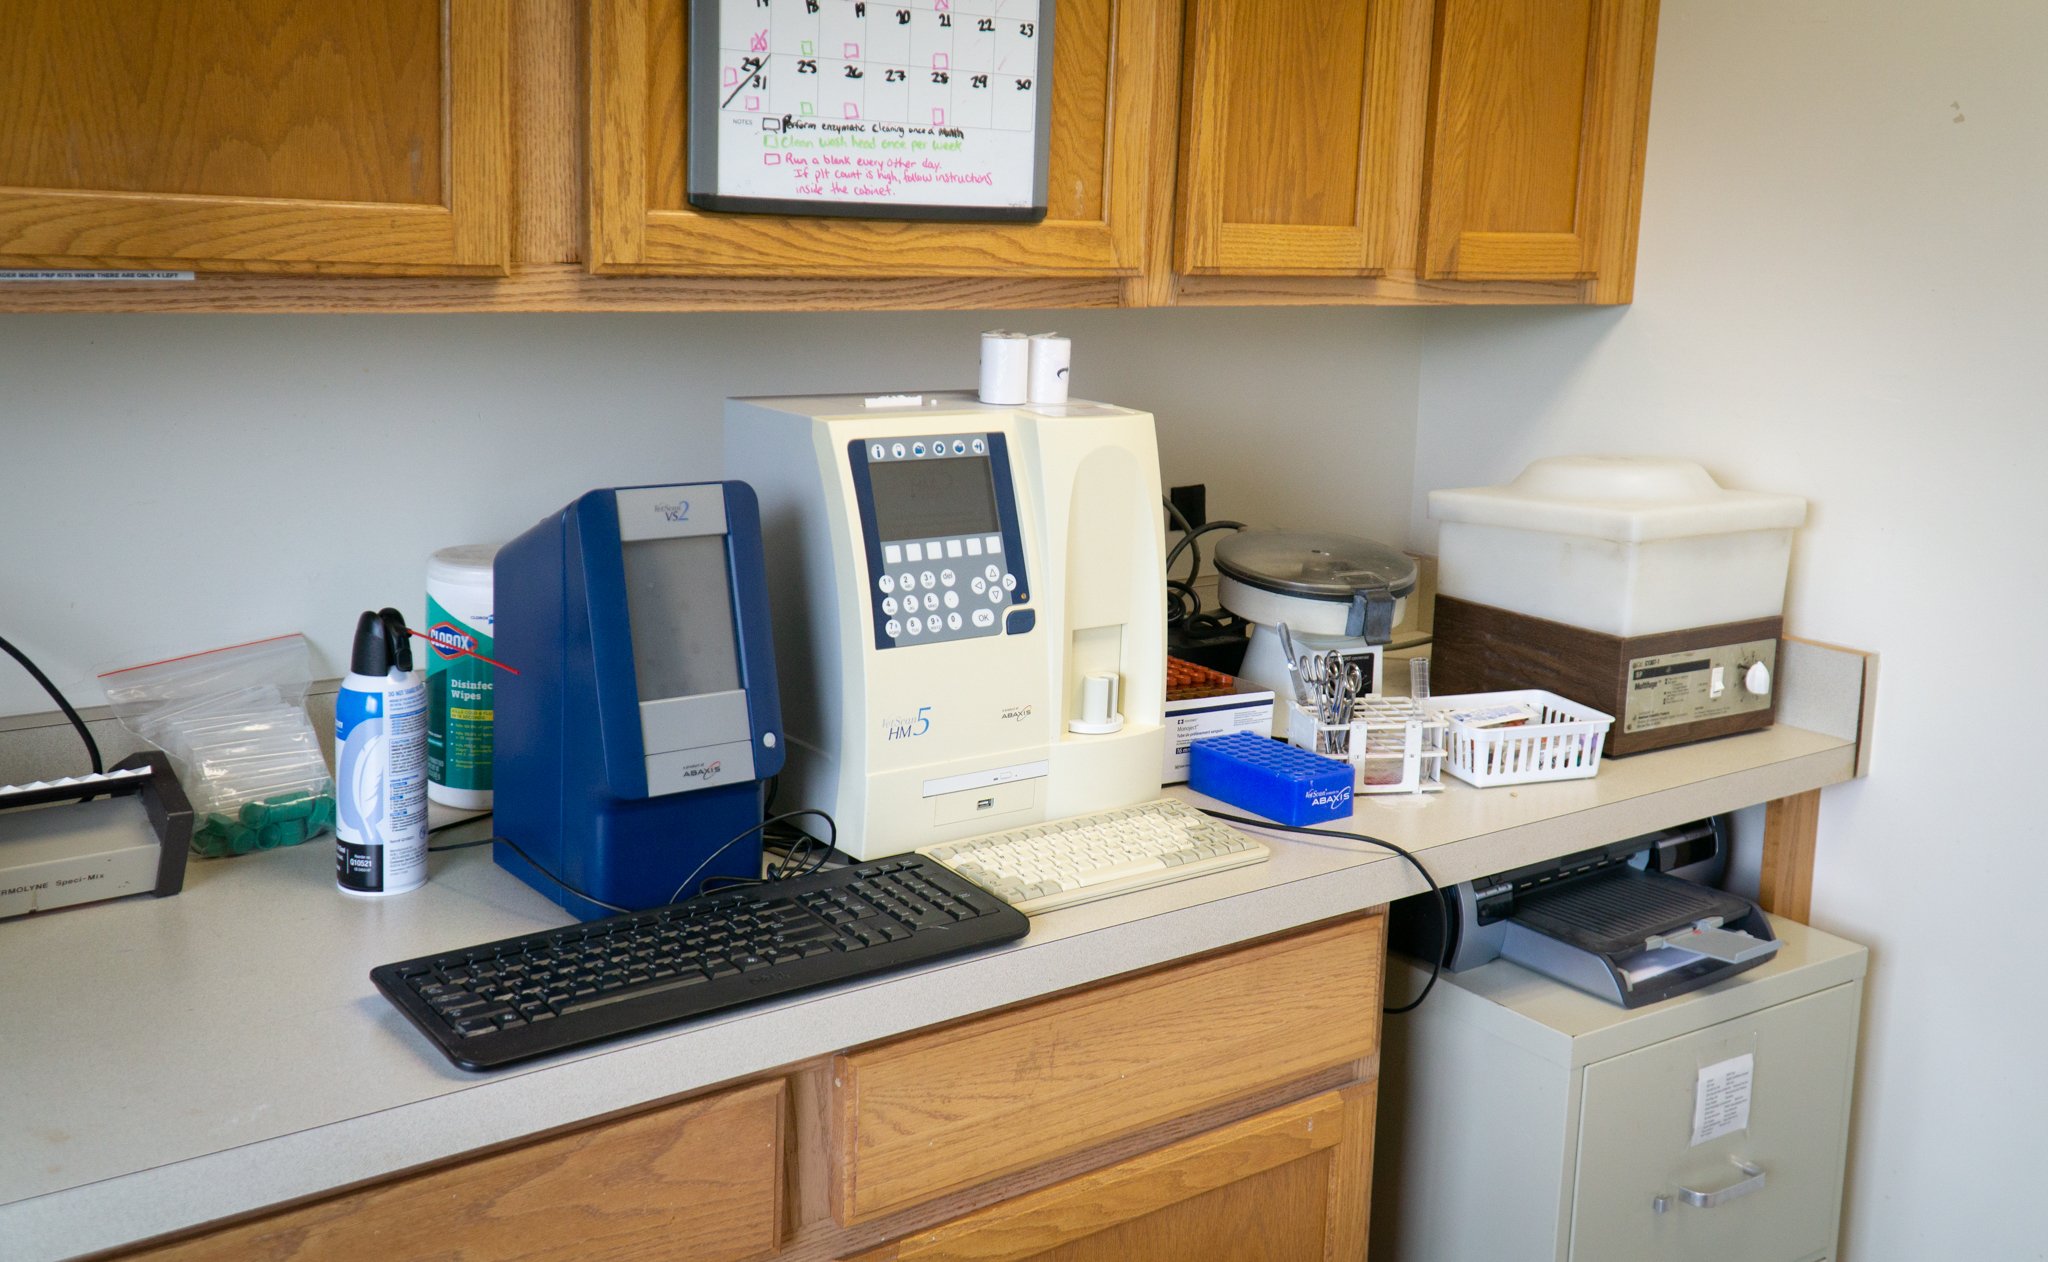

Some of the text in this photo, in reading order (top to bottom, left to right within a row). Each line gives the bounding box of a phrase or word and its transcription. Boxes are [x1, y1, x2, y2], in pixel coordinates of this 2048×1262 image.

[939, 13, 952, 27] 21
[978, 18, 996, 32] 22
[1020, 23, 1034, 38] 23
[752, 74, 767, 90] 31
[797, 59, 818, 74] 25
[844, 65, 864, 79] 26
[885, 69, 906, 82] 27
[931, 71, 950, 85] 28
[970, 74, 988, 89] 29
[1015, 79, 1032, 91] 30
[782, 114, 817, 134] Perform
[822, 121, 866, 134] enzymatic
[908, 127, 926, 135] once
[781, 134, 814, 149] Clean
[851, 134, 877, 149] head
[881, 140, 906, 150] once
[911, 140, 927, 152] per
[932, 139, 963, 152] week
[785, 152, 808, 165] Run
[811, 157, 820, 165] a
[823, 154, 851, 165] blank
[857, 158, 884, 171] every
[922, 157, 942, 173] day.
[794, 166, 993, 186] If plt count is high, follow instructions
[795, 181, 897, 197] inside the cabinet.
[978, 613, 989, 622] OK
[430, 628, 470, 651] CLOROX
[451, 679, 493, 690] Disinfec
[451, 689, 481, 702] Wipes
[1001, 708, 1032, 720] ABAXIS
[683, 765, 721, 778] ABAXIS
[1311, 789, 1350, 808] ABAXIS
[56, 873, 104, 887] Speci-Mix
